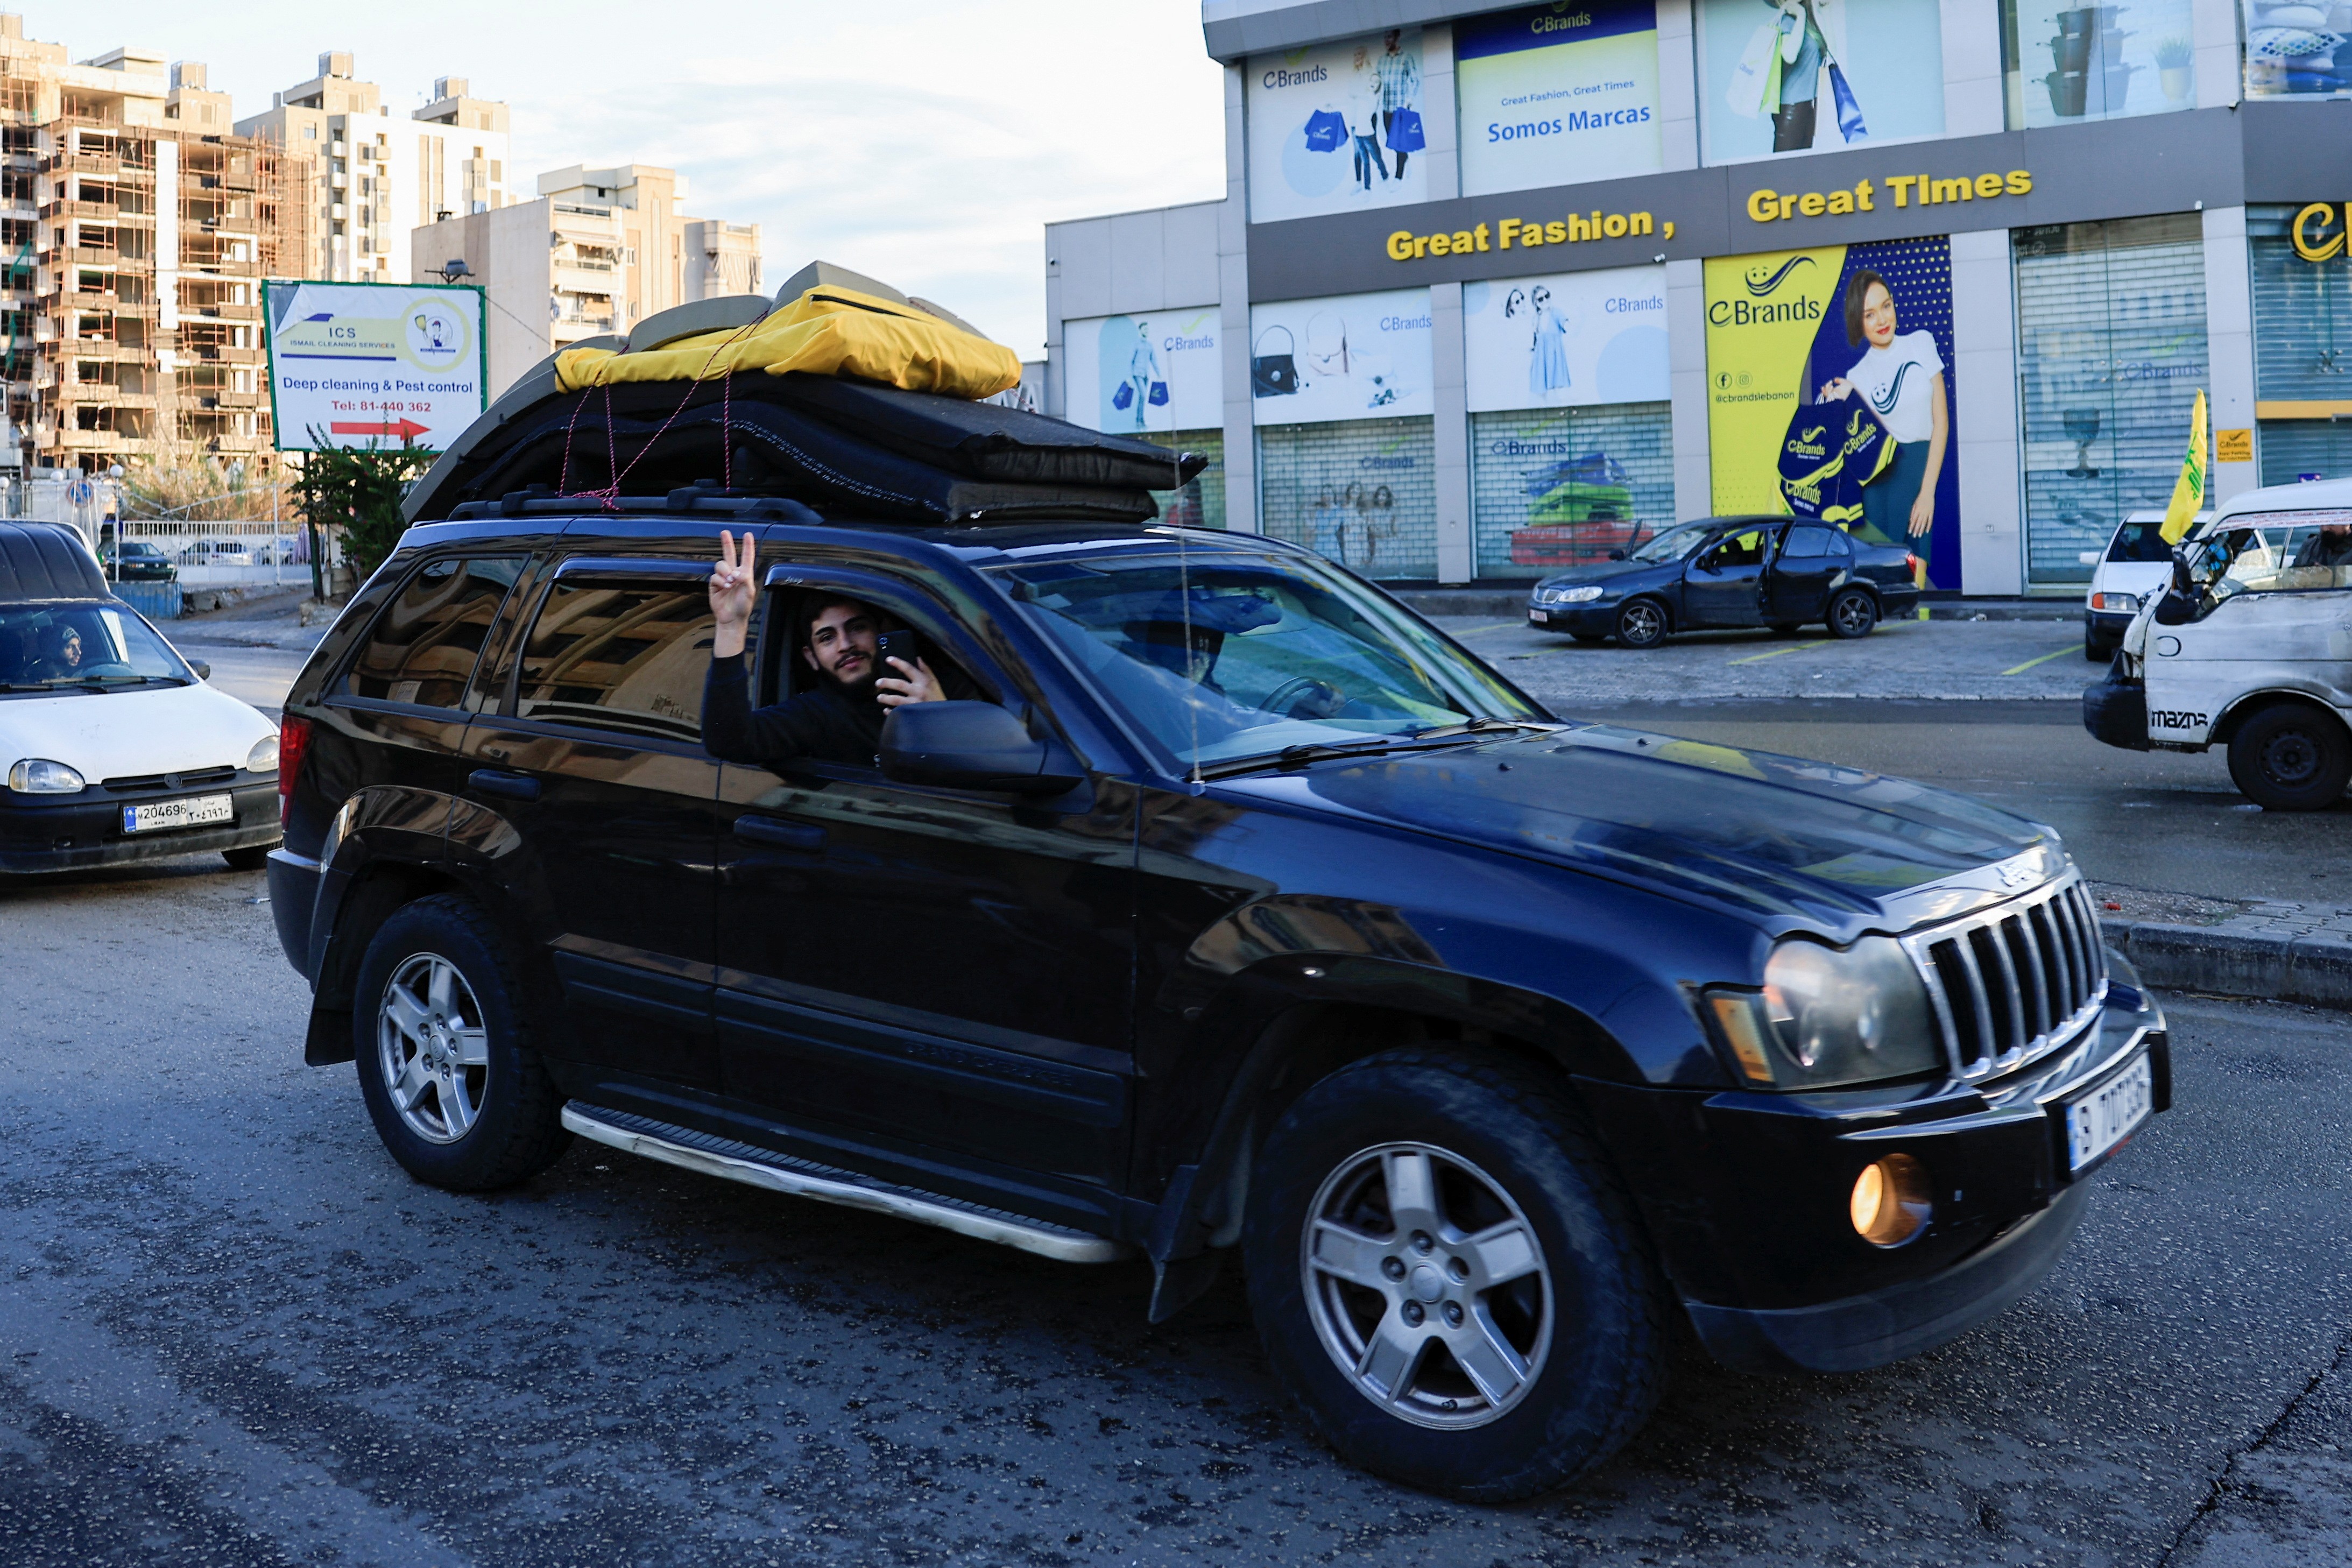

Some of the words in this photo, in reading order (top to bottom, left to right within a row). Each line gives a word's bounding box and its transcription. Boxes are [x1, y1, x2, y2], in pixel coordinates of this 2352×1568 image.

[1501, 96, 1527, 106] Great
[1531, 89, 1571, 103] Fashion,
[1574, 84, 1601, 95] Great
[1604, 80, 1634, 90] Times
[1488, 119, 1562, 142] Somos
[1569, 107, 1650, 131] Marcas
[1387, 222, 1490, 260] Great
[1747, 179, 1874, 222] Great
[1885, 169, 2032, 208] Times
[2292, 202, 2352, 262] C
[1710, 295, 1820, 327] CBrands
[329, 327, 356, 338] ICS
[283, 377, 318, 392] Deep
[322, 379, 379, 393] cleaning
[383, 380, 392, 391] &
[396, 380, 425, 392] Pest
[428, 382, 472, 393] control
[331, 400, 356, 411] Tel:
[361, 401, 404, 412] 81-440
[408, 402, 431, 412] 362
[1716, 392, 1795, 403] @cbrandslebanon
[144, 804, 186, 819] 204696
